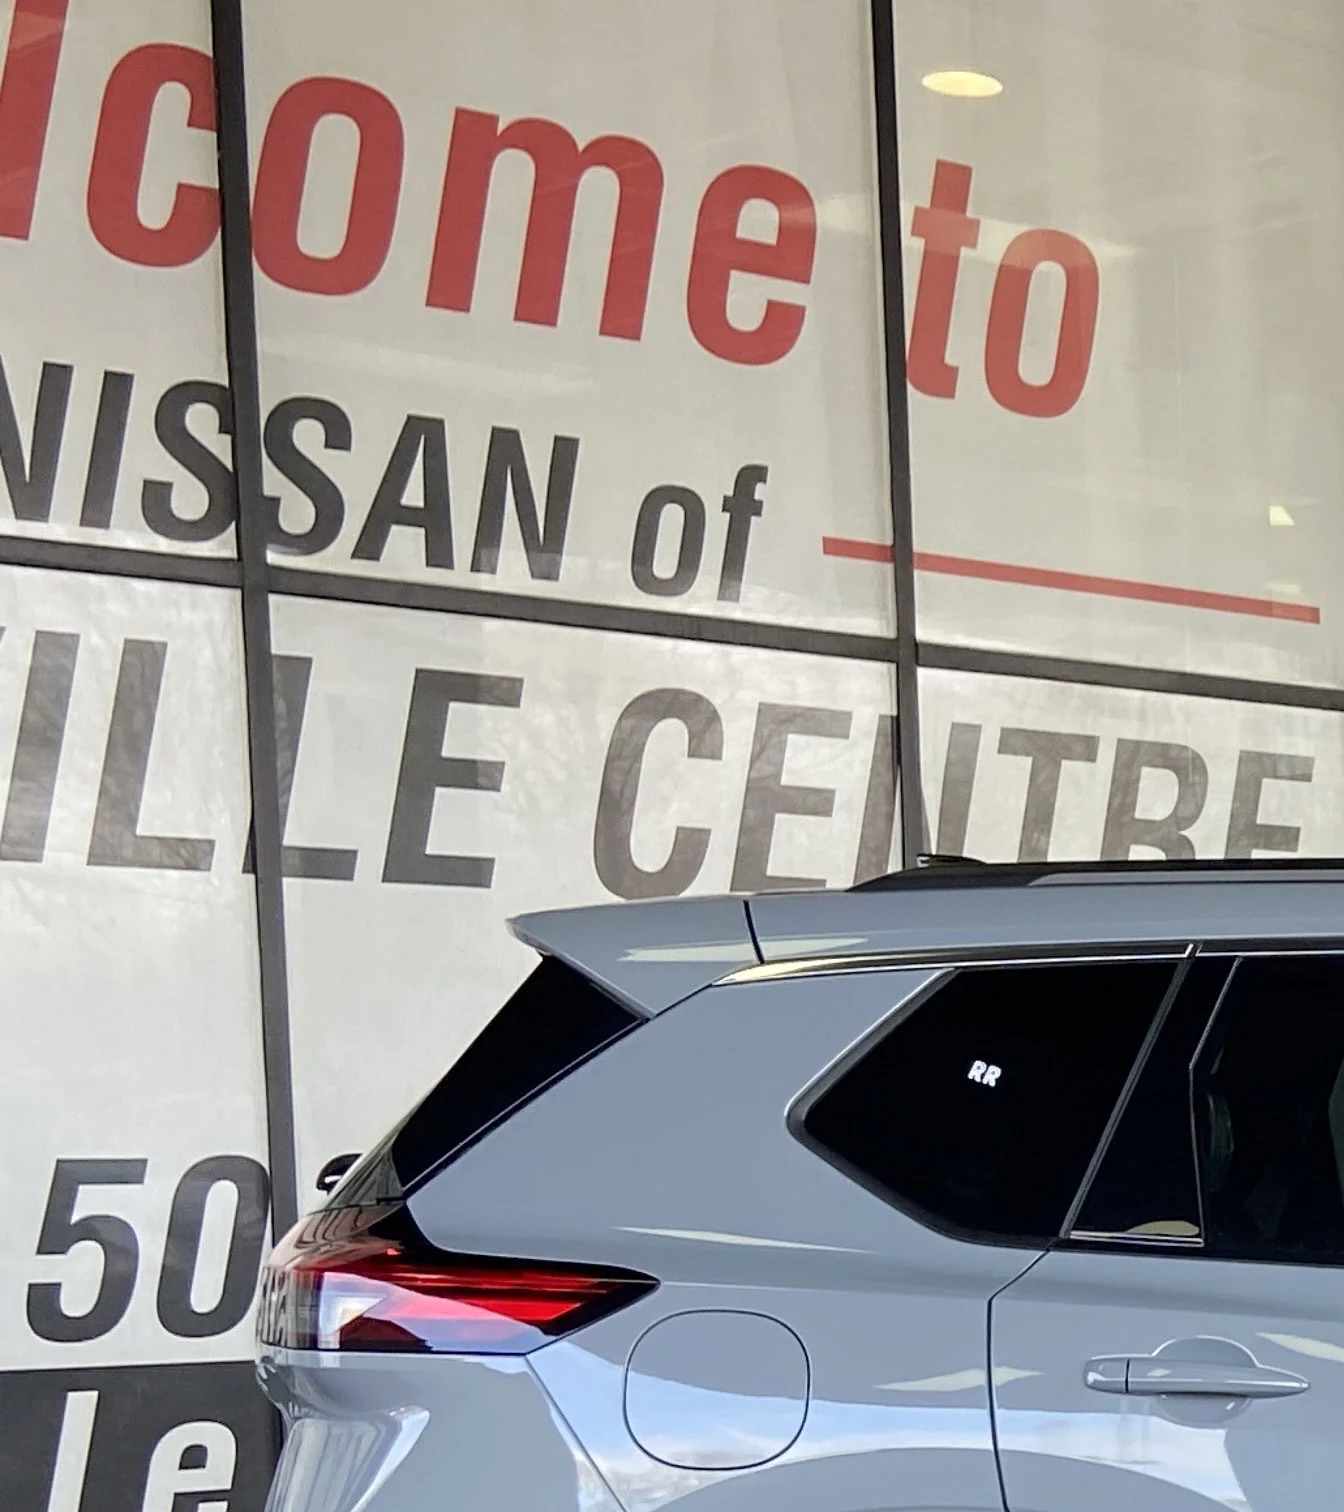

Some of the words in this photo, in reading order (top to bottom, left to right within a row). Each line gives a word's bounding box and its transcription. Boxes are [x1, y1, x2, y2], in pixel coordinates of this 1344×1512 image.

[0, 0, 818, 366] lcome
[905, 157, 1102, 418] to
[0, 352, 581, 582] NISSAN
[631, 463, 769, 603] of
[0, 626, 524, 888] ILLE
[593, 686, 1316, 898] CENTRE
[967, 1059, 1002, 1087] RR
[26, 1153, 363, 1344] 50
